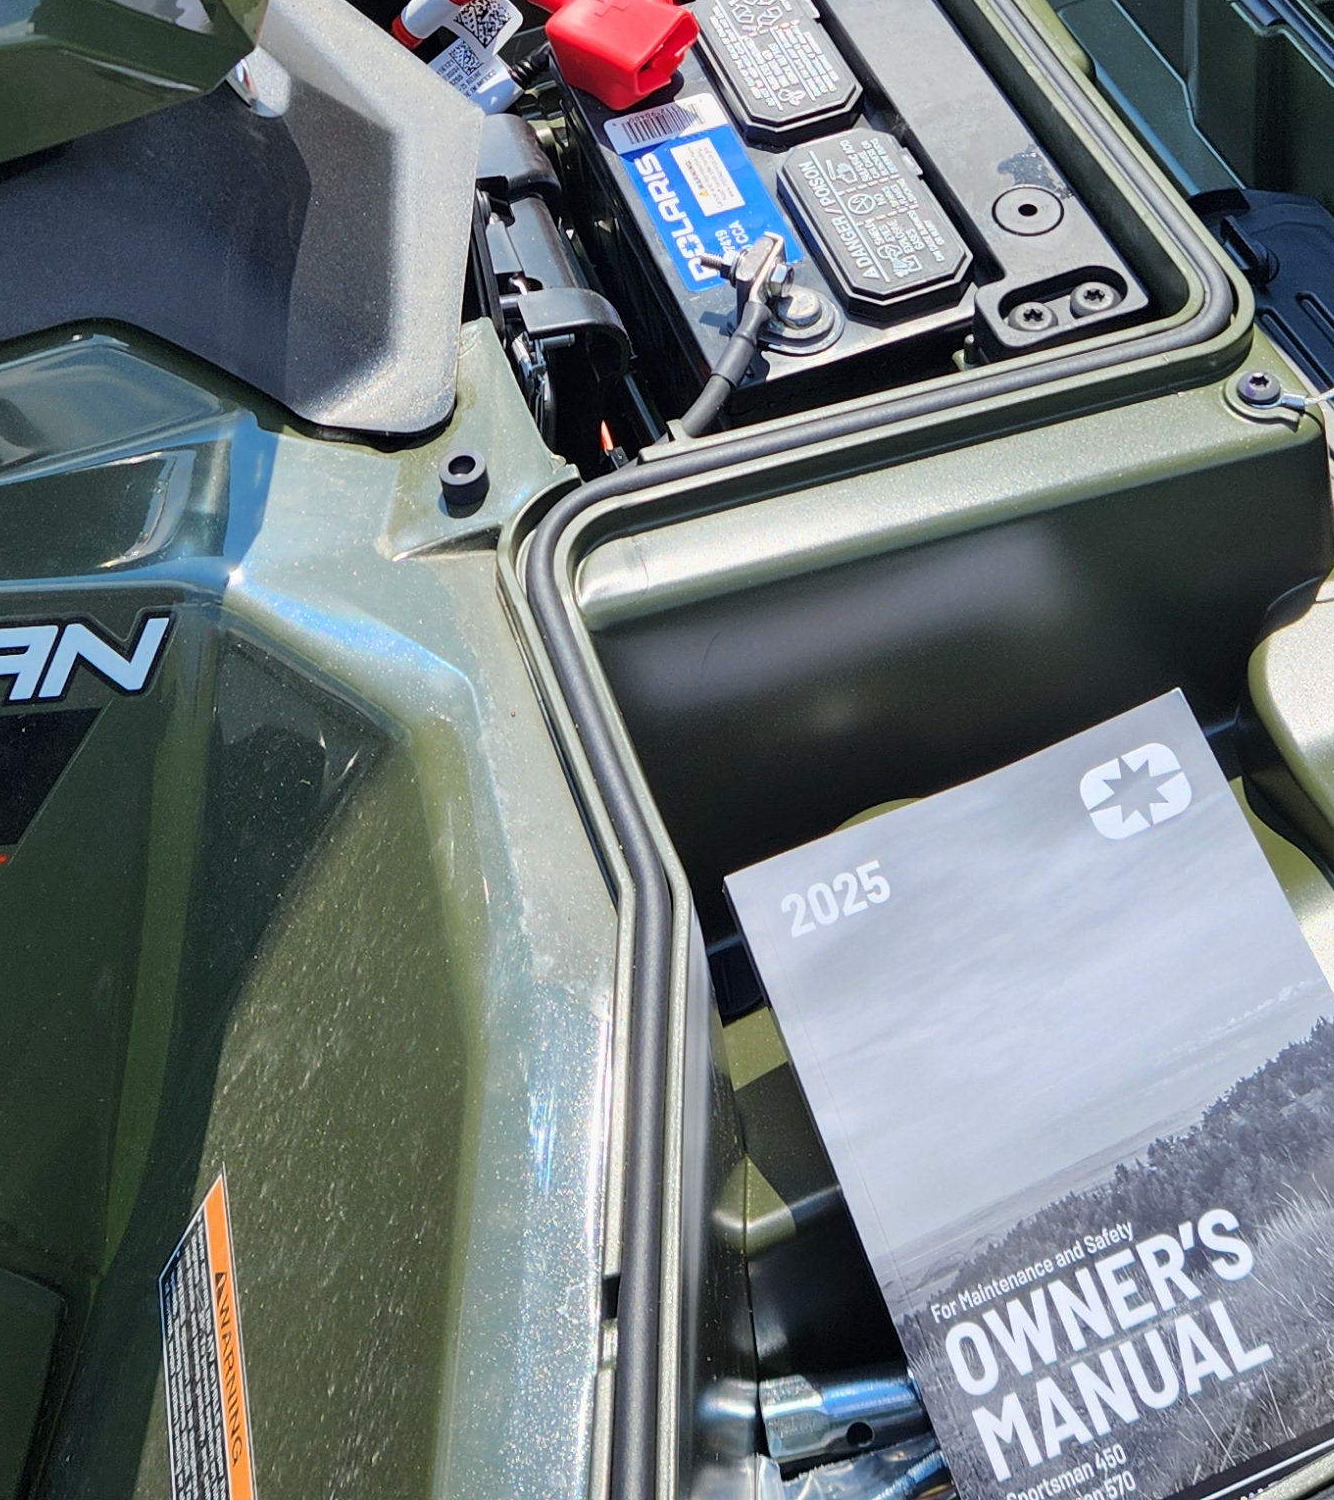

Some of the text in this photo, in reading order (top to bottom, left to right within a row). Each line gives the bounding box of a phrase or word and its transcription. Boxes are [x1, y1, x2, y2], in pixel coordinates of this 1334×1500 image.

[476, 69, 496, 86] MEXICO
[798, 161, 835, 205] POISON
[872, 192, 886, 205] NO
[632, 151, 718, 281] POLARIS
[713, 228, 736, 252] 7419
[726, 219, 750, 244] CCA
[830, 216, 872, 267] DANGER
[904, 228, 925, 250] GASES
[779, 861, 891, 940] 2025
[932, 1221, 1134, 1324] For Maintenance and Safety
[206, 1332, 215, 1362] ATV
[219, 1292, 243, 1467] WARNING
[974, 1300, 1273, 1481] MANUAL
[1095, 1443, 1127, 1470] 450
[1104, 1470, 1136, 1500] 570
